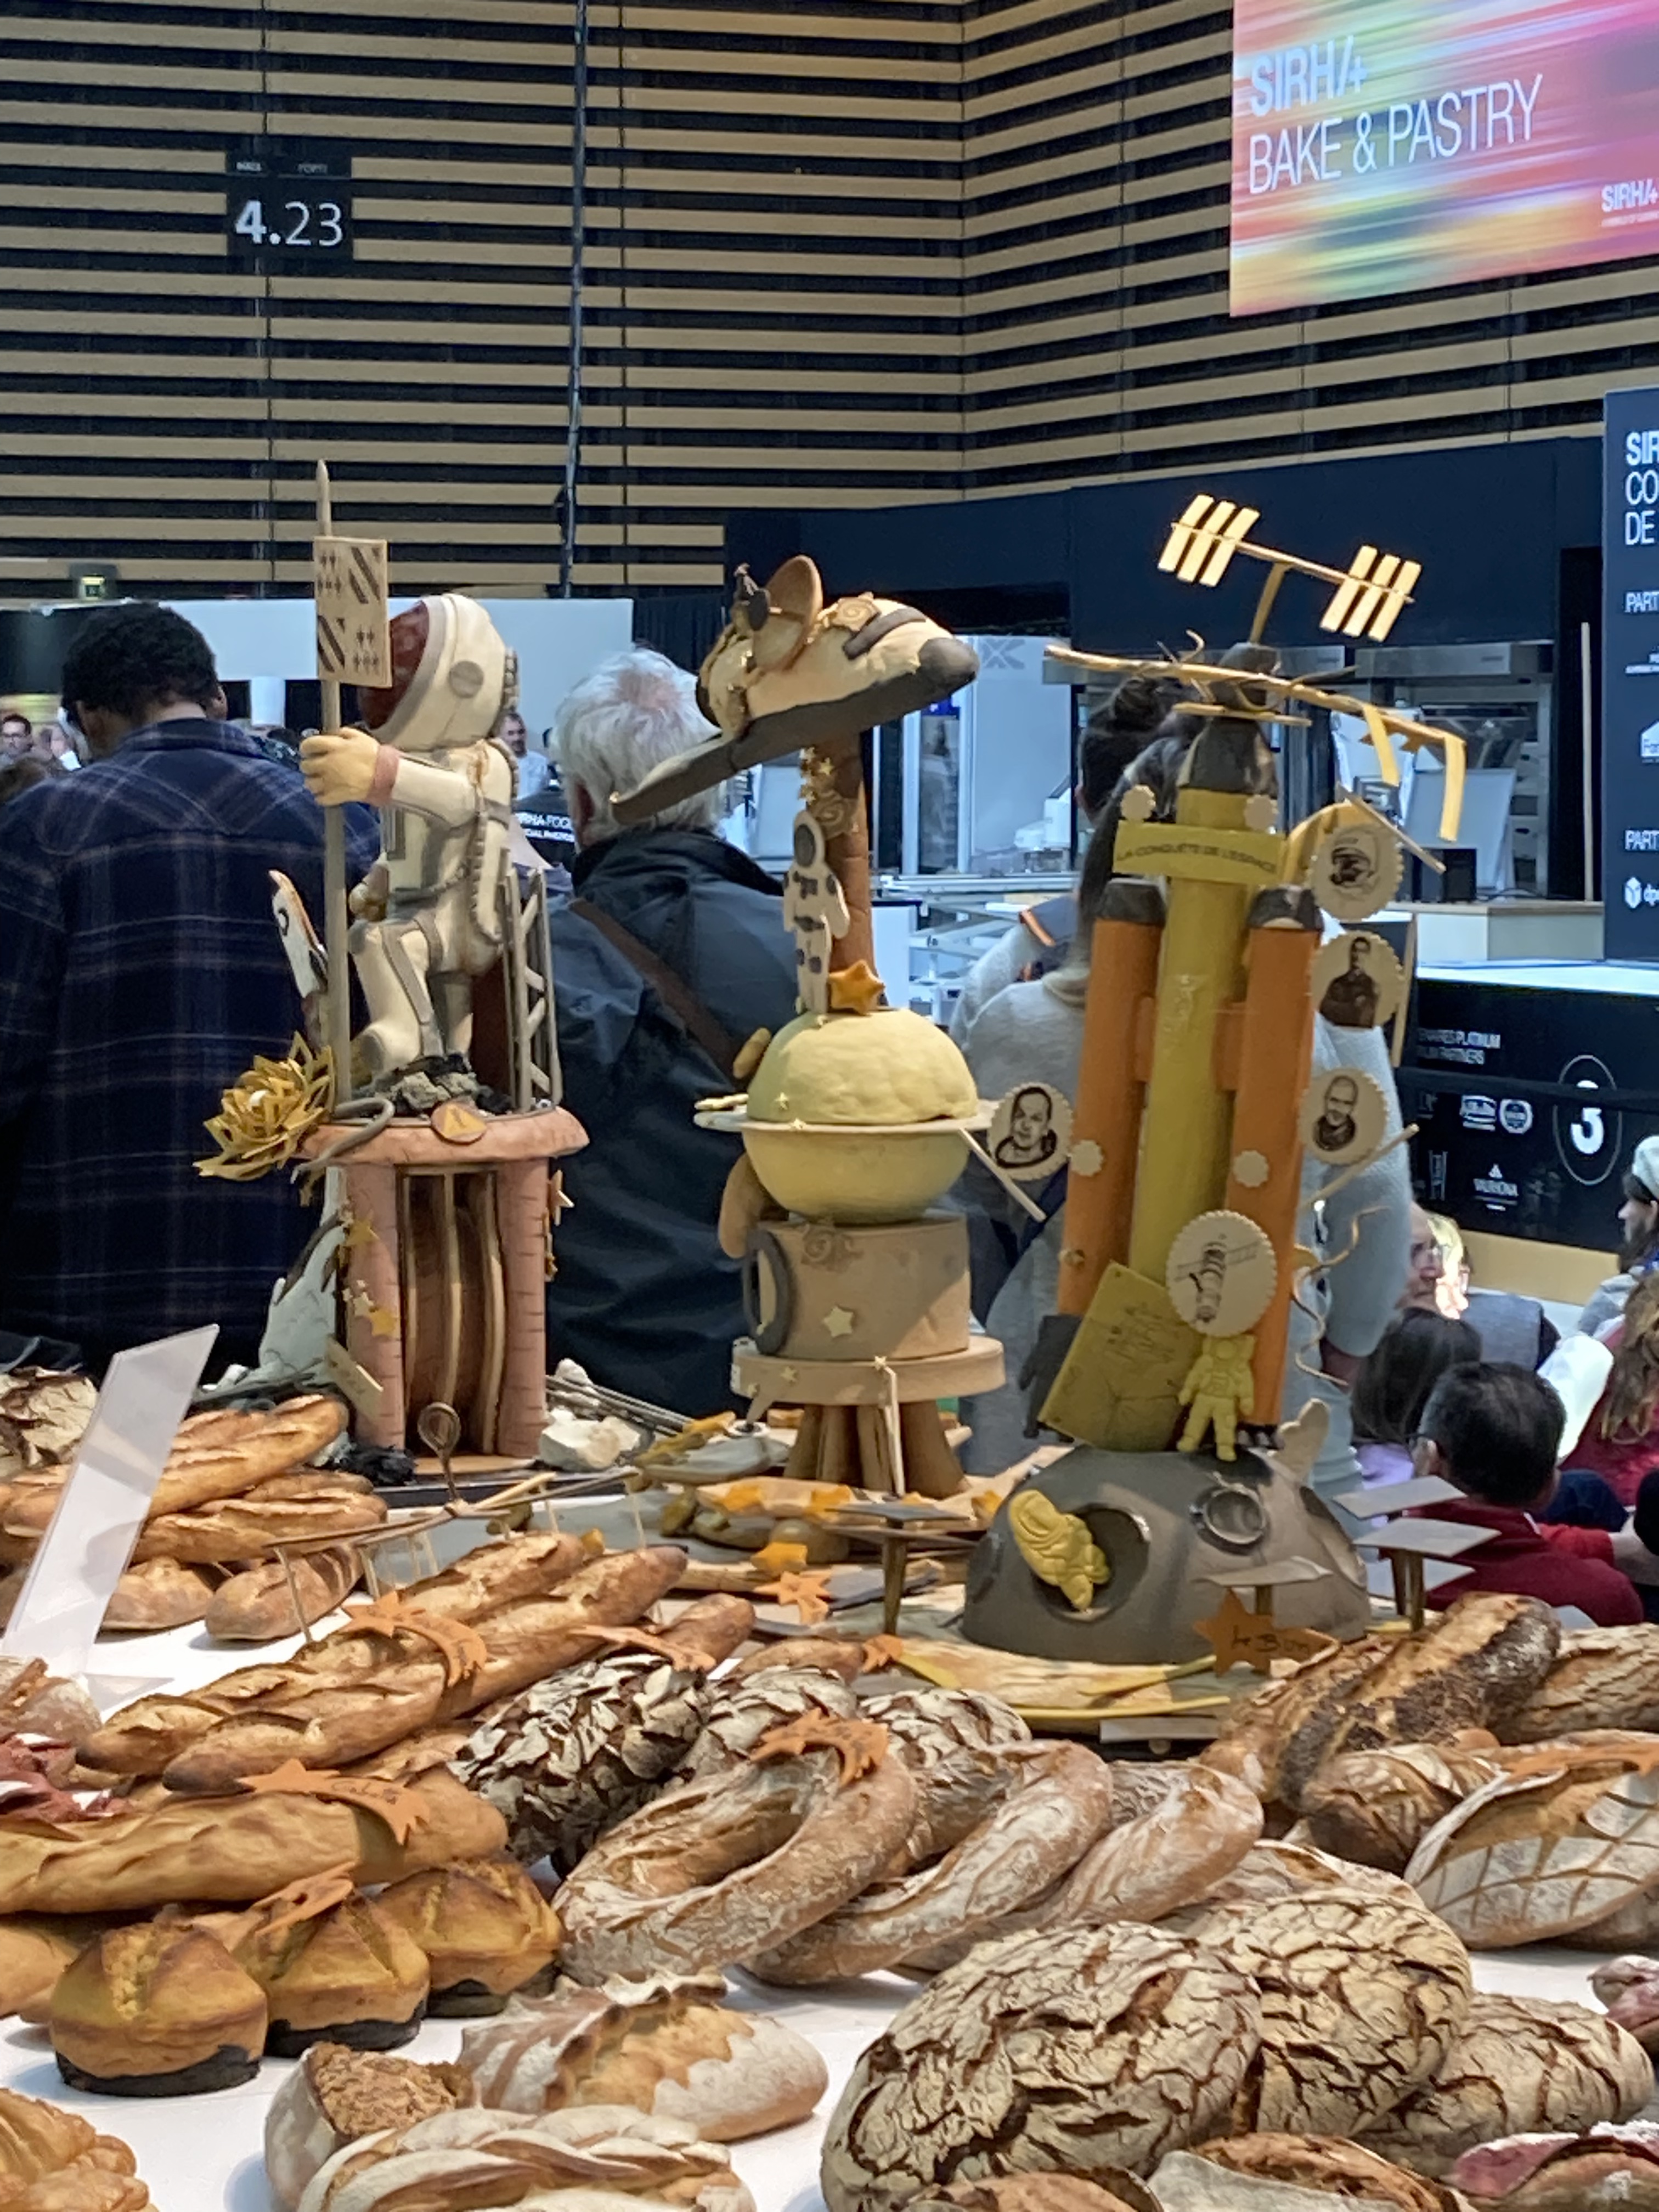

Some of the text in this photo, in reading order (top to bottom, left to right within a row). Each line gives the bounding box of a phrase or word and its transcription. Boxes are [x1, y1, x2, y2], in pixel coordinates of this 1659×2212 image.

[1250, 74, 1543, 194] BAKE & PASTRY
[235, 200, 343, 246] 4.23
[1625, 510, 1656, 545] DE
